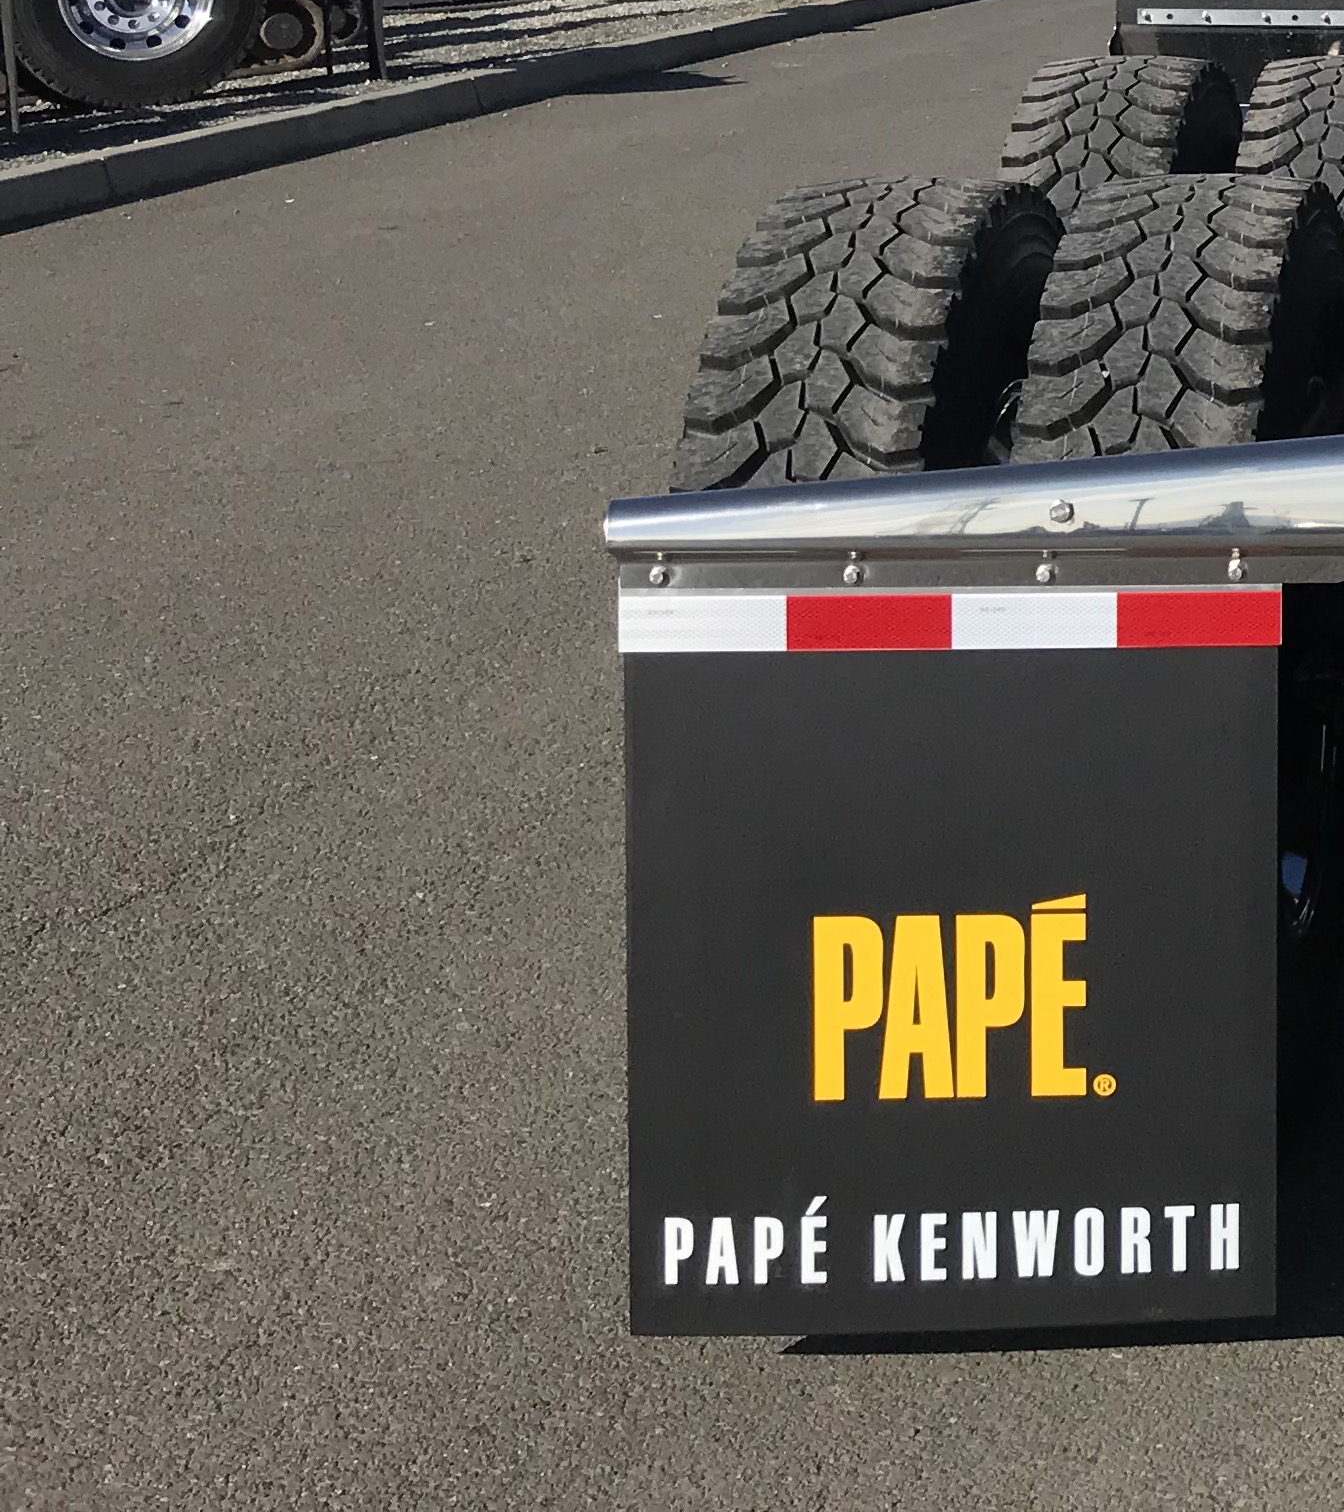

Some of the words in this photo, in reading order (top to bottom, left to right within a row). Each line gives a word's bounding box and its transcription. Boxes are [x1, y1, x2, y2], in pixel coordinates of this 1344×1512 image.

[812, 893, 1088, 1102] PAPÉ
[663, 1195, 828, 1285] PAPÉ
[873, 1203, 1240, 1283] KENWORTH
